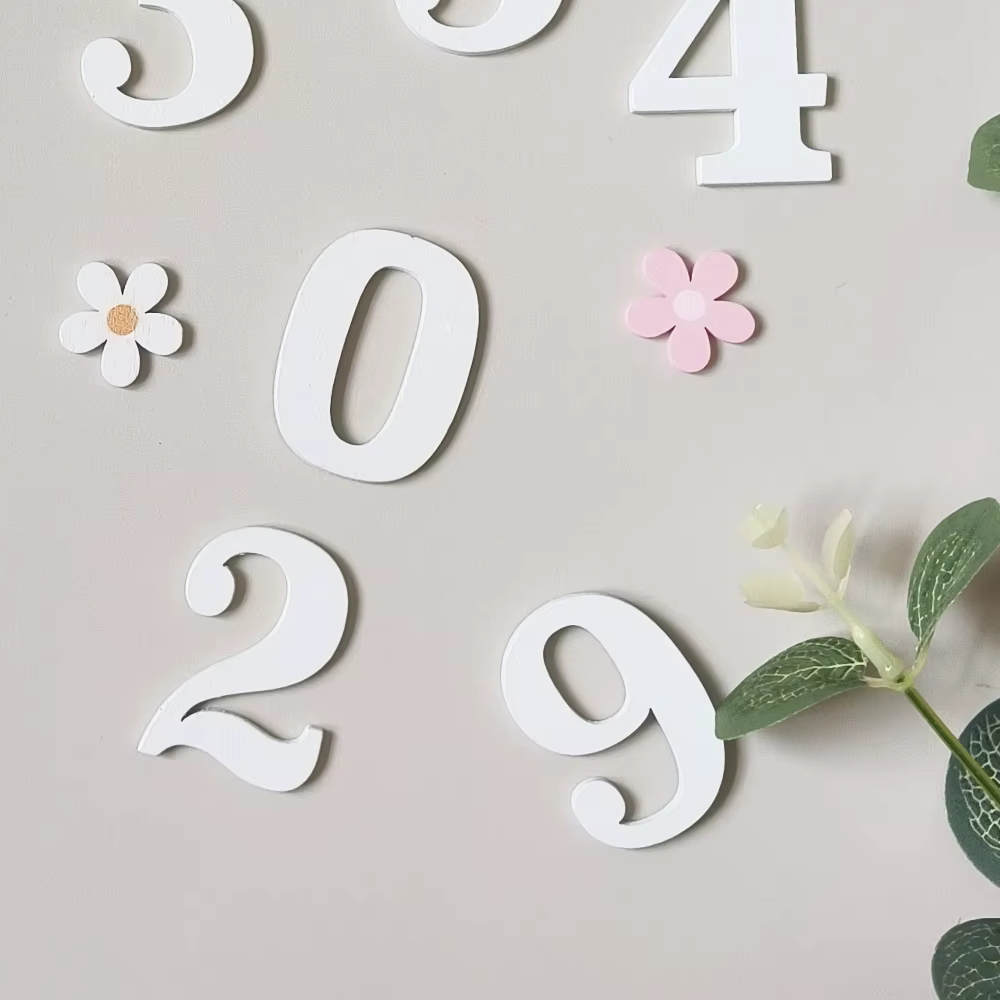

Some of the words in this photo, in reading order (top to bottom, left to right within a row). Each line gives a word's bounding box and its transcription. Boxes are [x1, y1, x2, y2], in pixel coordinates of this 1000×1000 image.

[274, 228, 480, 484] 0
[138, 525, 349, 792] 2
[500, 591, 726, 850] 9
